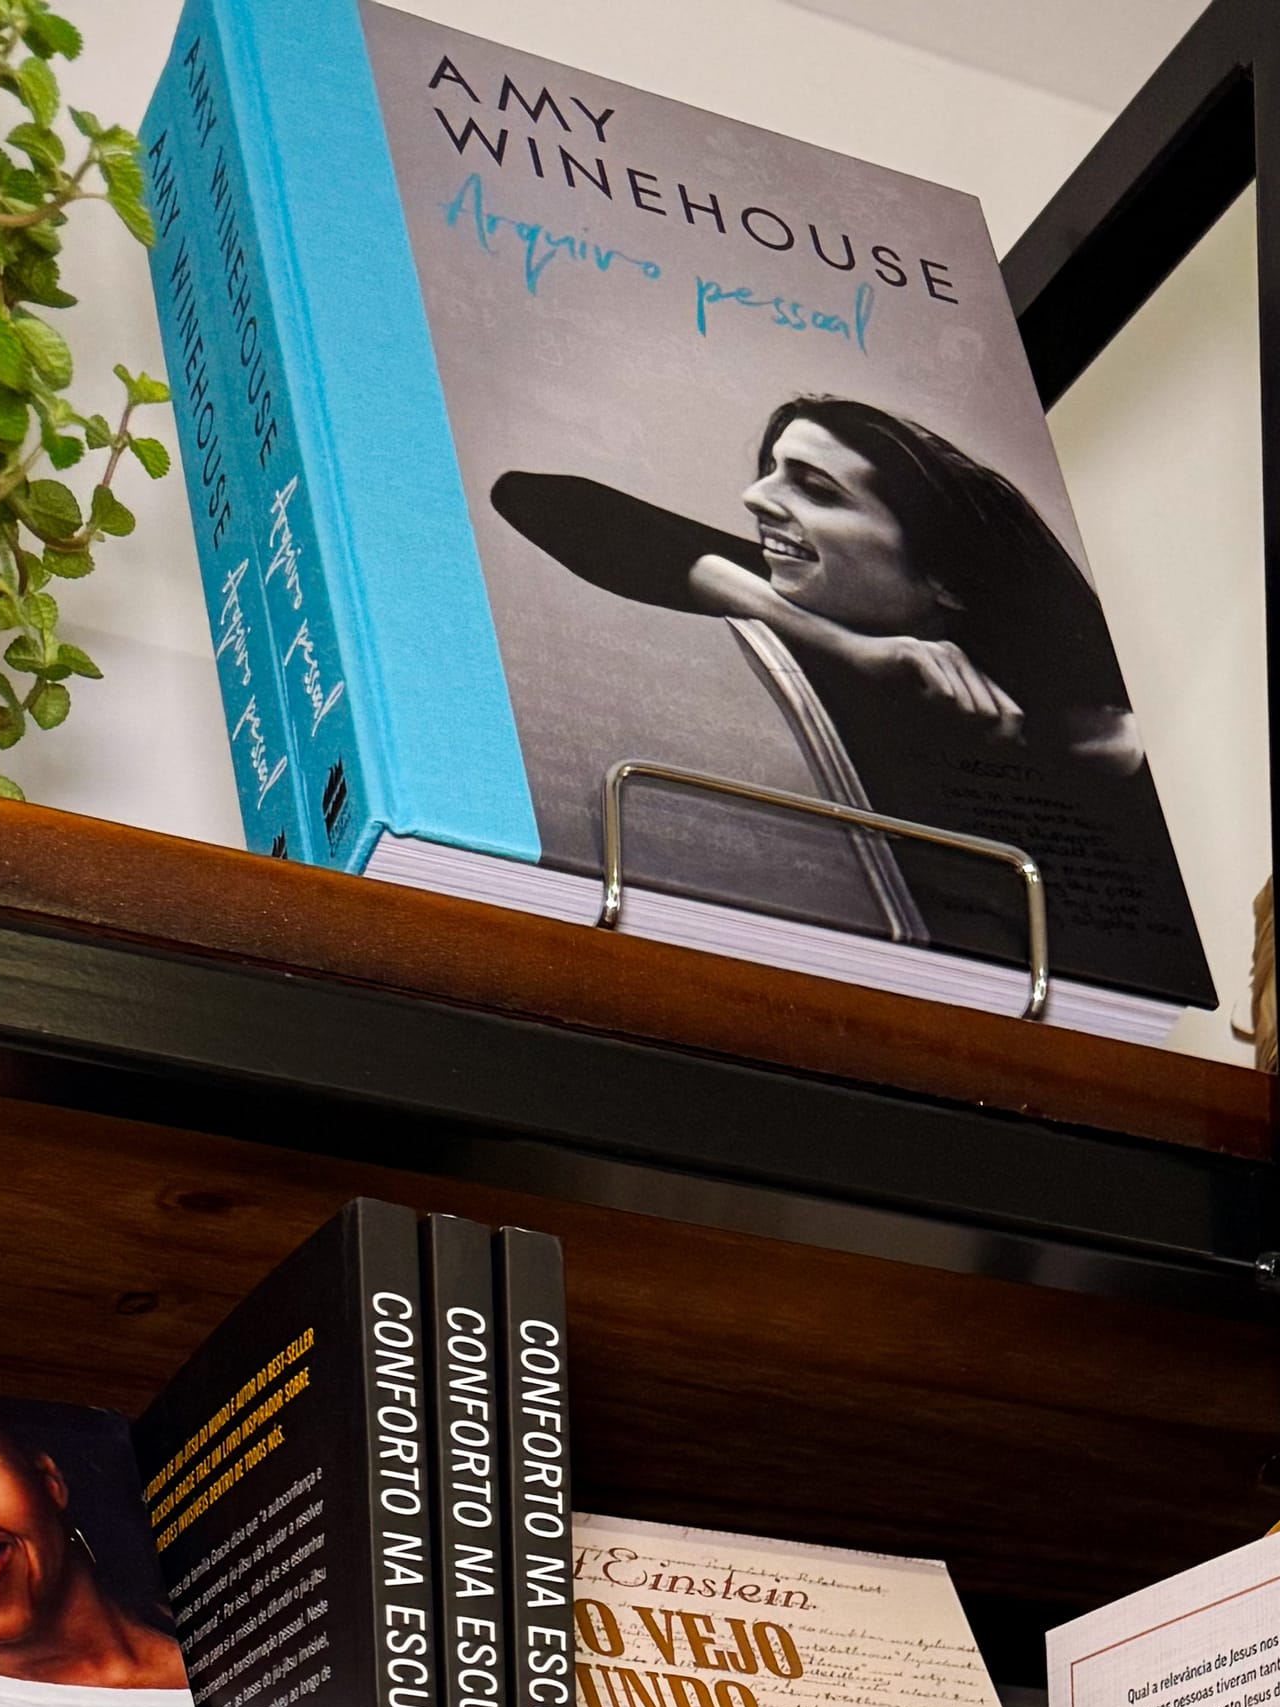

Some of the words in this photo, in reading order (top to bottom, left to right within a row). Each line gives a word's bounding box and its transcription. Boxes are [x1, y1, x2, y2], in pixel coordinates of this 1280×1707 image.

[427, 54, 617, 143] AMY
[432, 105, 961, 307] WINEHOUSE
[441, 172, 663, 298] Arquivo
[690, 272, 876, 352] pessoal
[372, 1292, 420, 1514] CONFORTO
[382, 1531, 423, 1585] NA
[602, 1547, 817, 1610] Einstein
[632, 1605, 804, 1679] VEJO
[1128, 1682, 1150, 1704] Qual
[1160, 1660, 1212, 1690] relevância
[1214, 1654, 1227, 1670] de
[1229, 1644, 1257, 1666] Jesus
[1260, 1639, 1279, 1654] nos
[1216, 1669, 1258, 1695] tiveram
